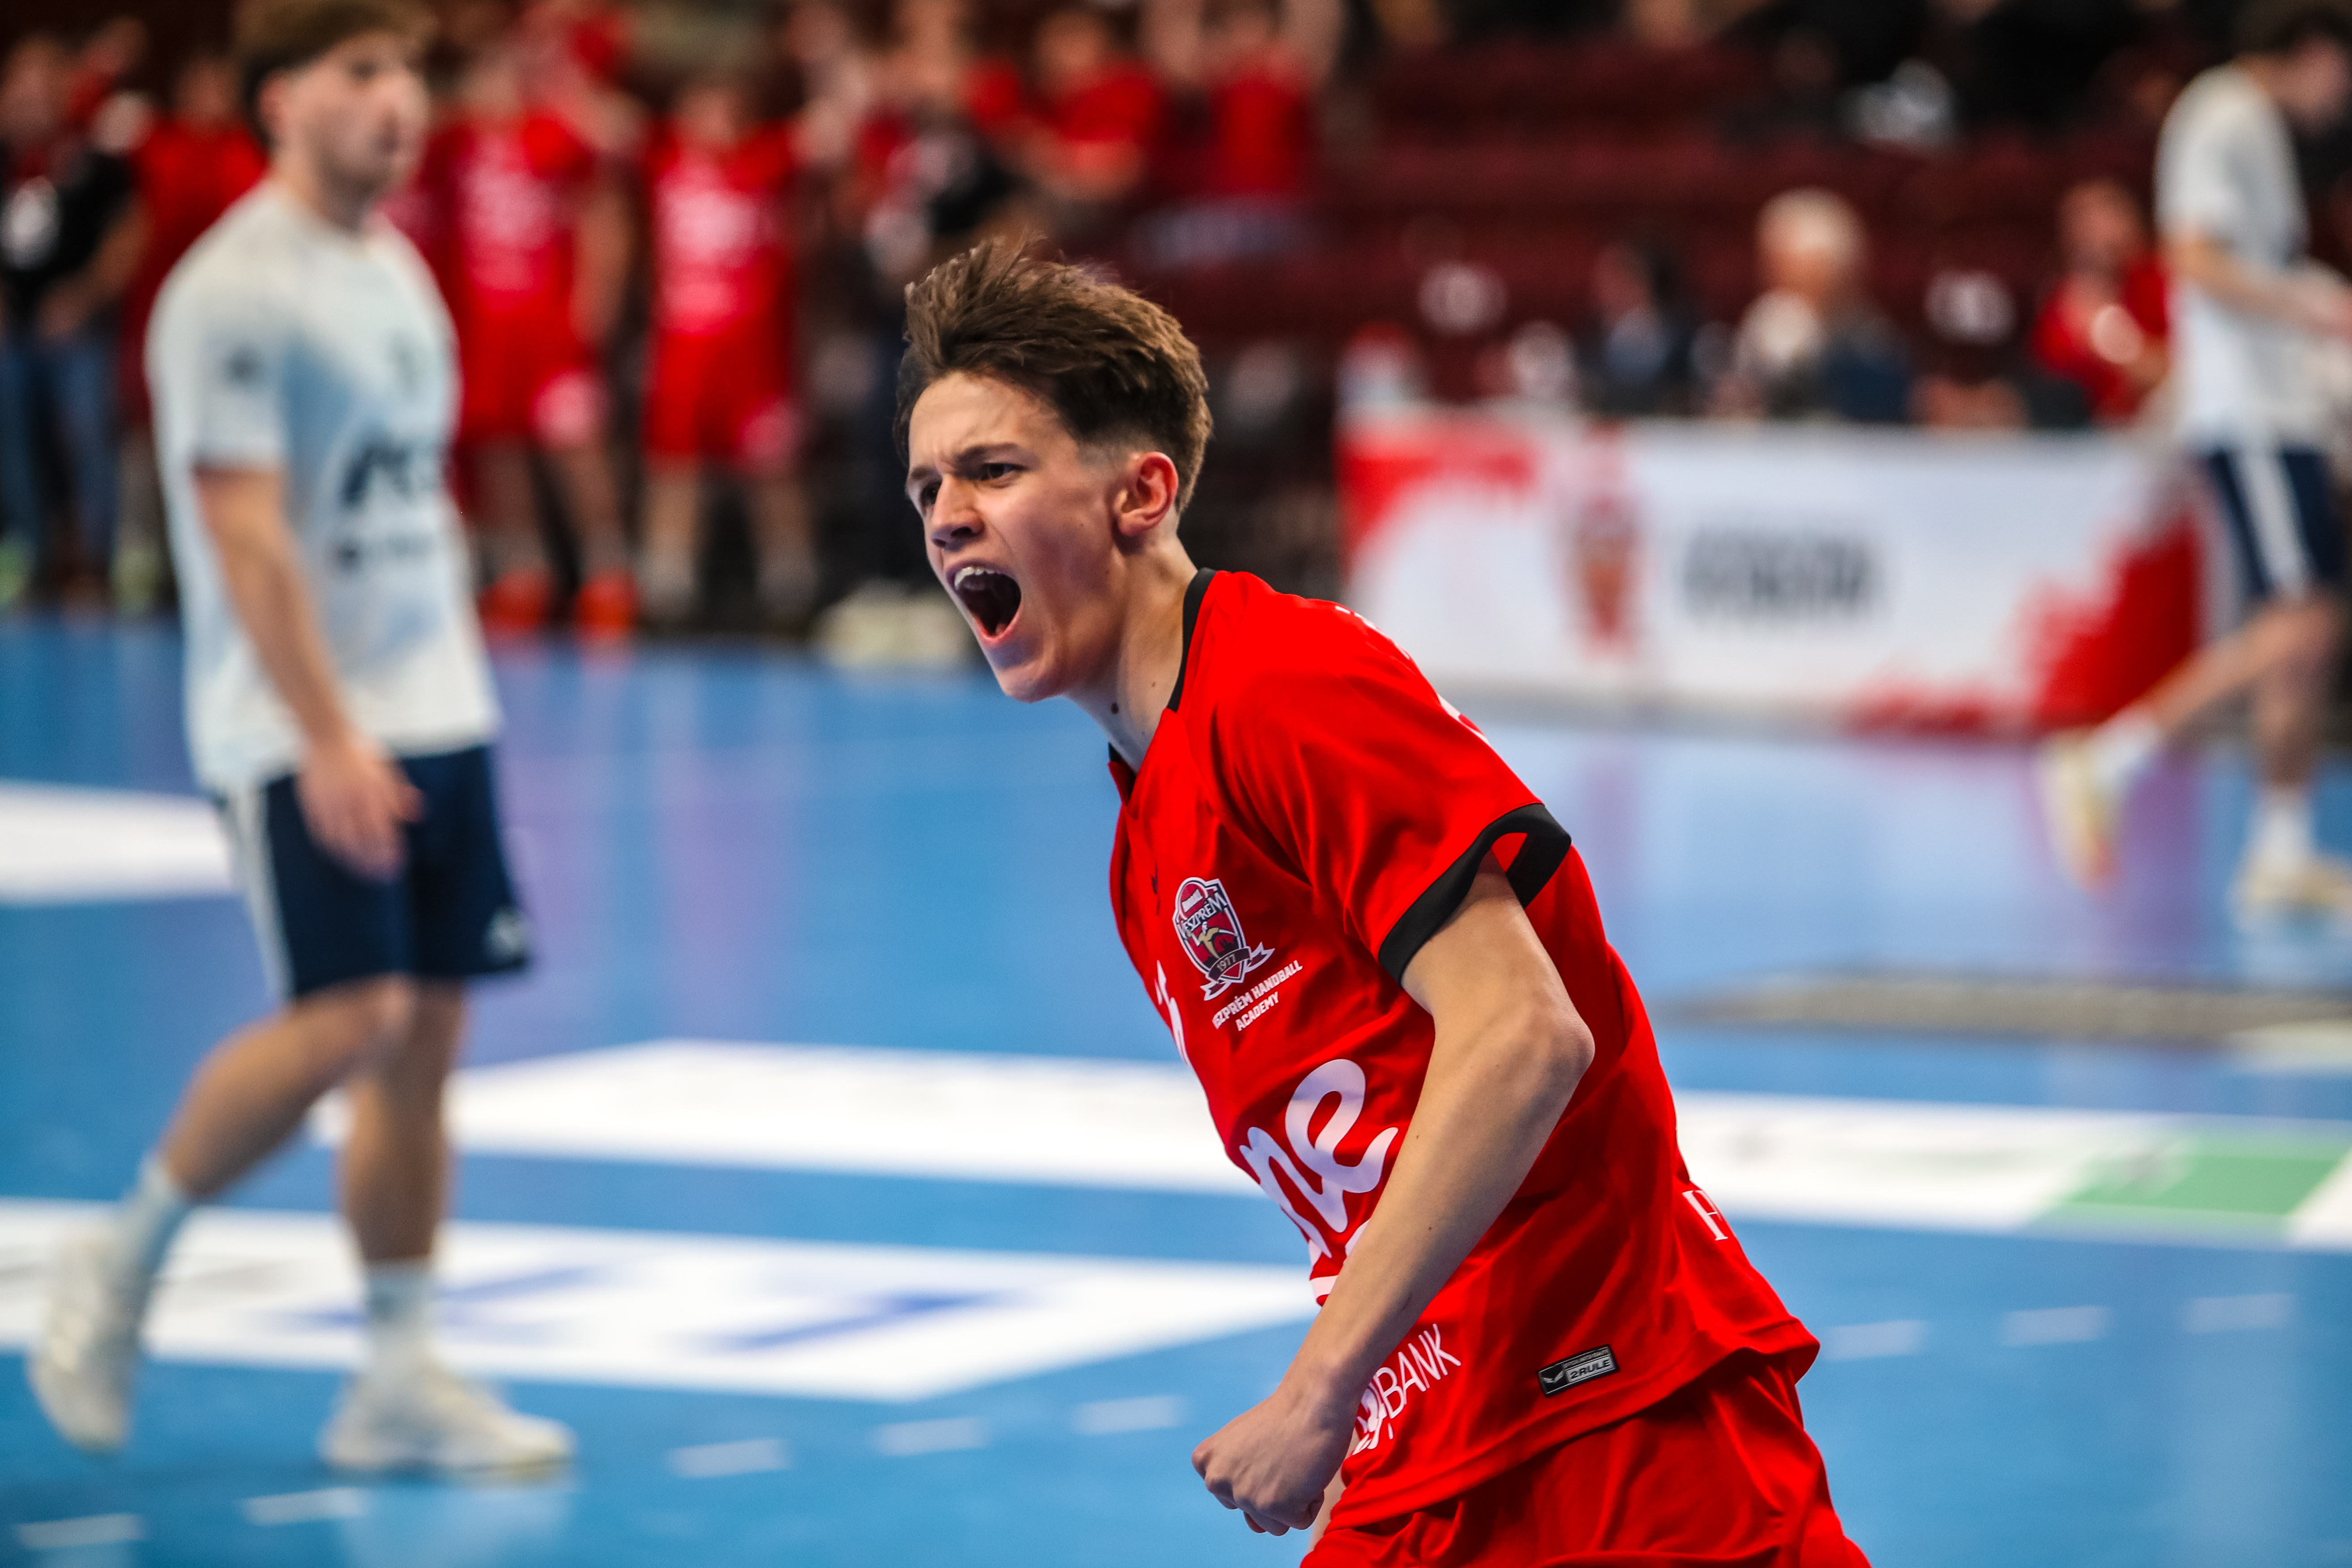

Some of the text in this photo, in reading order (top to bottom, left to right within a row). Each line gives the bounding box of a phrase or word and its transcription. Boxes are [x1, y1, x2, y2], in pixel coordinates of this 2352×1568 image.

[1217, 954, 1236, 971] 1977
[1251, 960, 1303, 999] HANDBALL
[1235, 991, 1279, 1031] ACADEMY
[1239, 1059, 1398, 1259] ne
[1373, 1323, 1462, 1419] BANK
[1571, 1359, 1611, 1379] 2RULE
